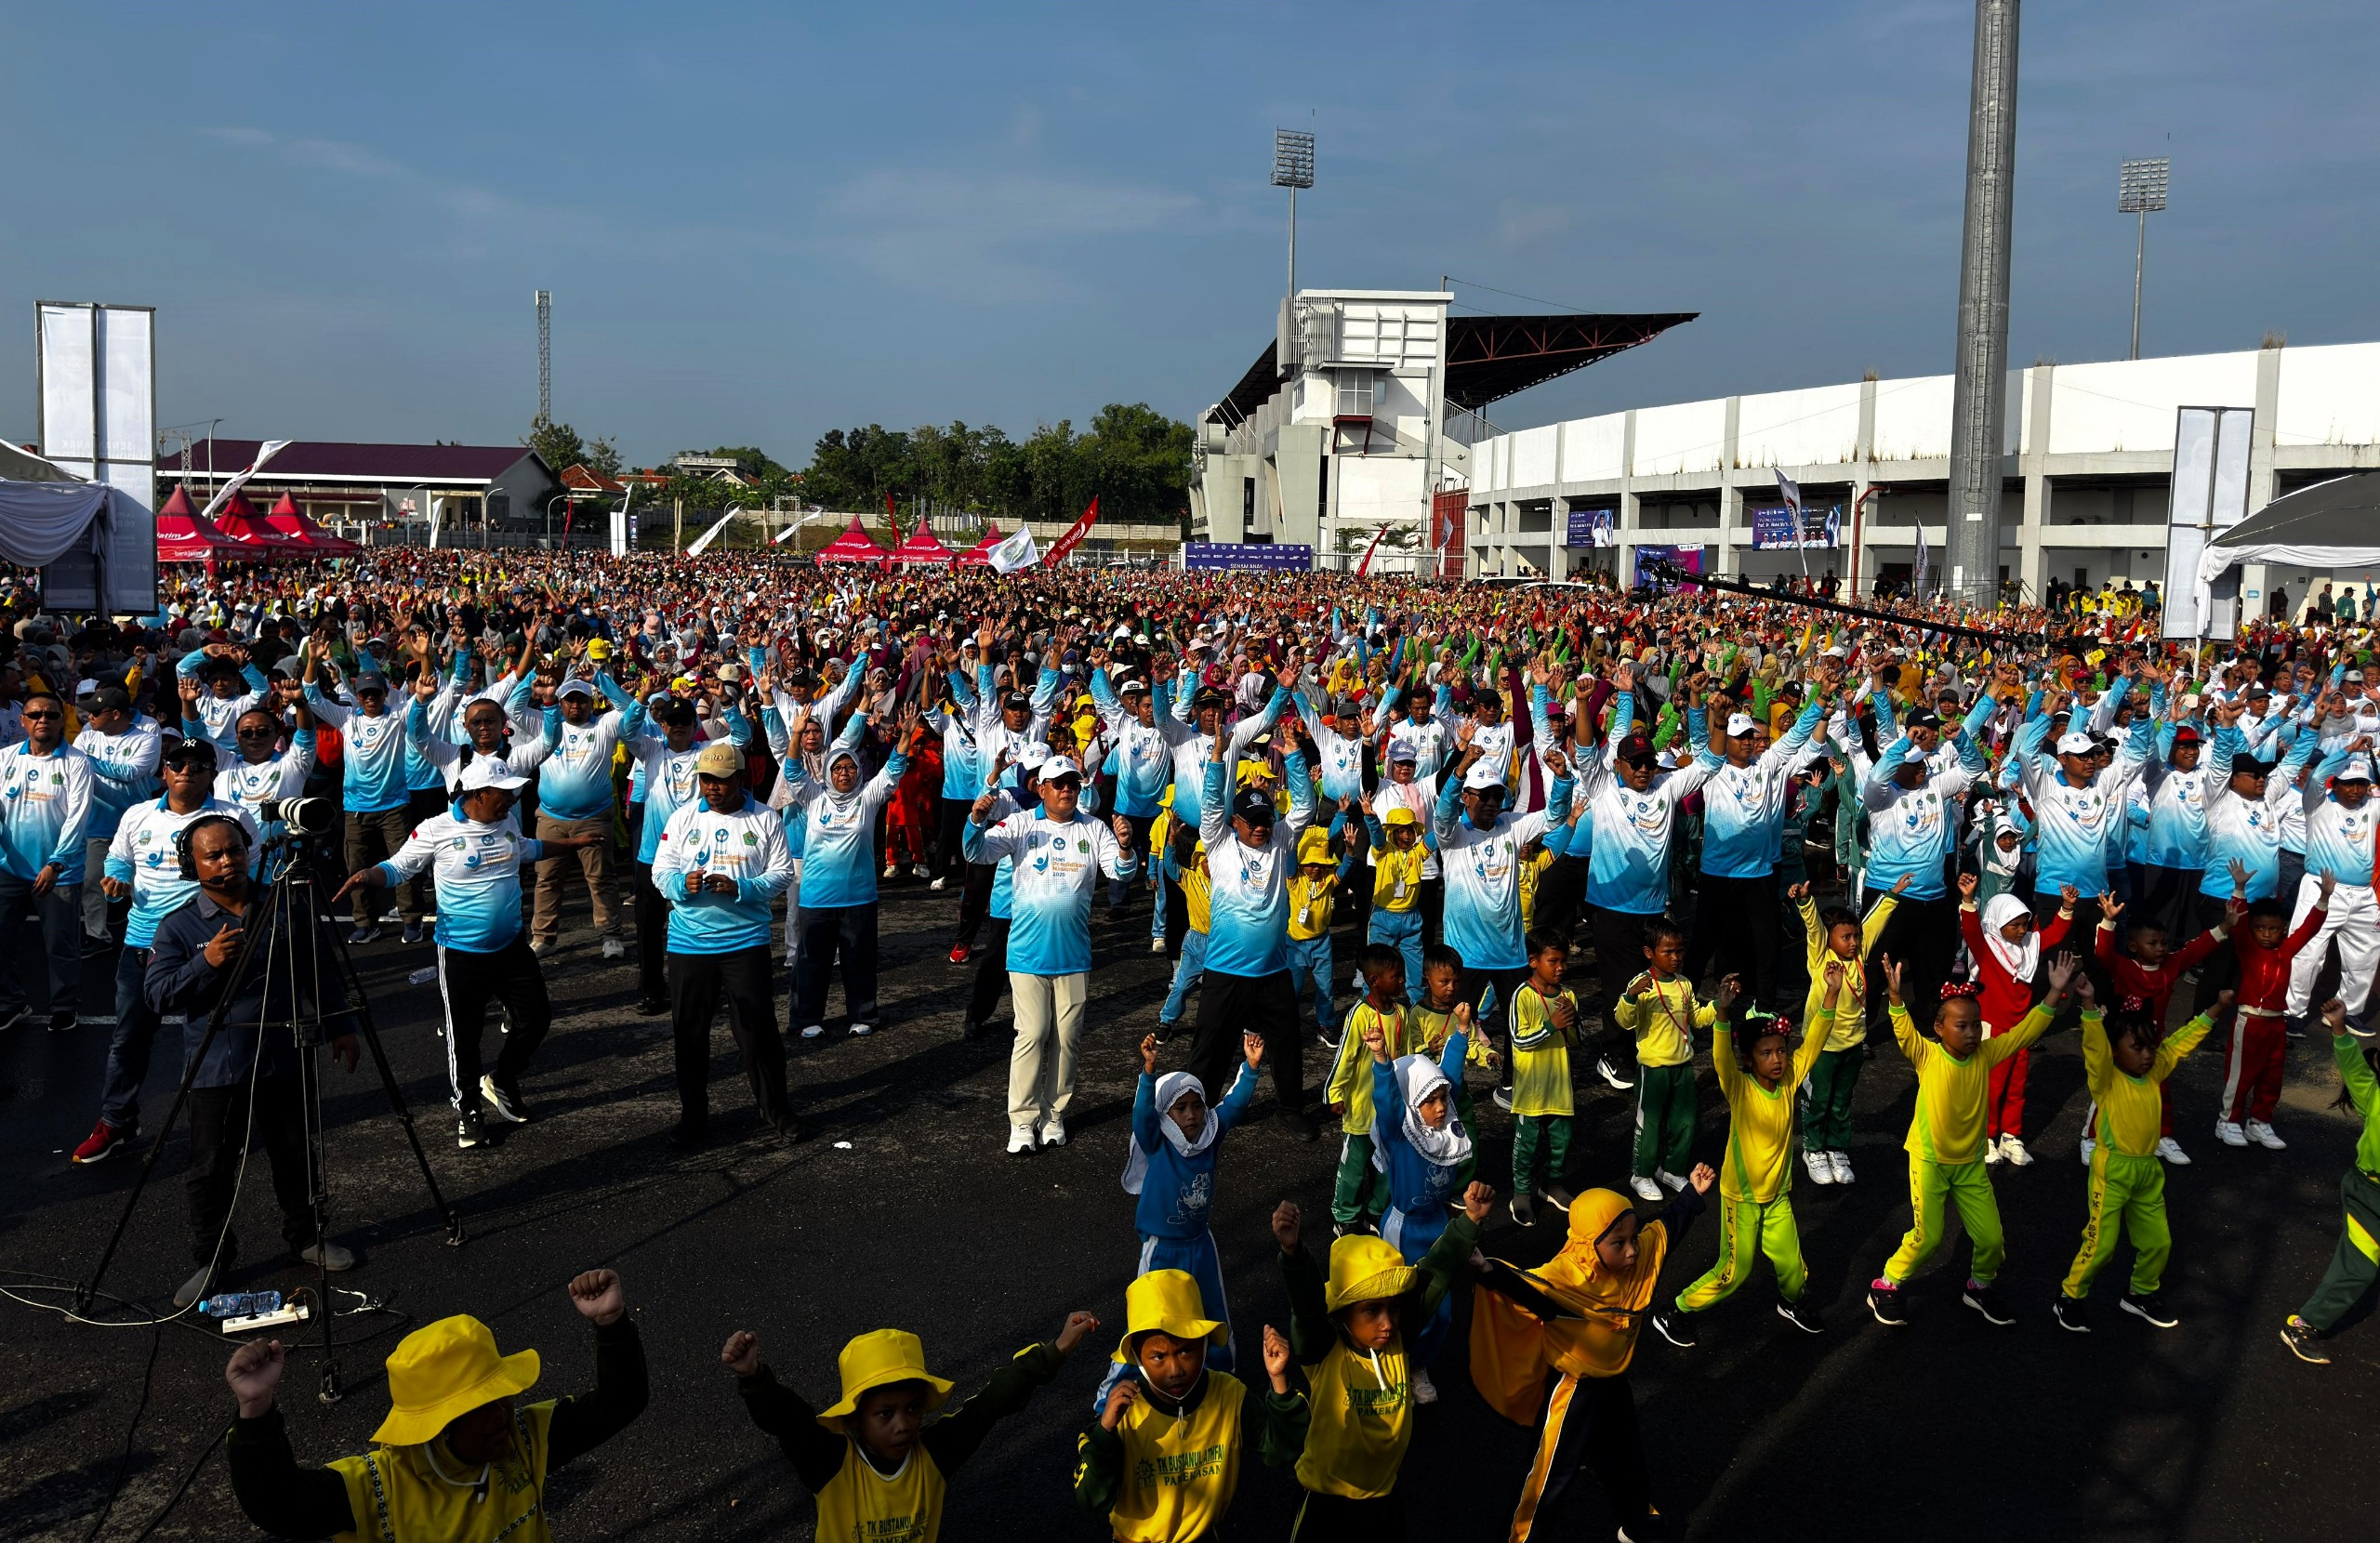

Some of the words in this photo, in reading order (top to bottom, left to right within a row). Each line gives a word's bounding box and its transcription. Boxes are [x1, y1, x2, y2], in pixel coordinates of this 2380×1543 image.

[2092, 1192, 2102, 1207] TK
[2081, 1216, 2097, 1264] PERTIWI
[1357, 1404, 1401, 1417] PAMEKA
[1157, 1457, 1169, 1472] TK
[1169, 1451, 1202, 1472] BUSTANUL
[1164, 1465, 1221, 1486] PAMEKASAN
[866, 1521, 877, 1534] TK
[879, 1515, 913, 1534] BUSTANUL
